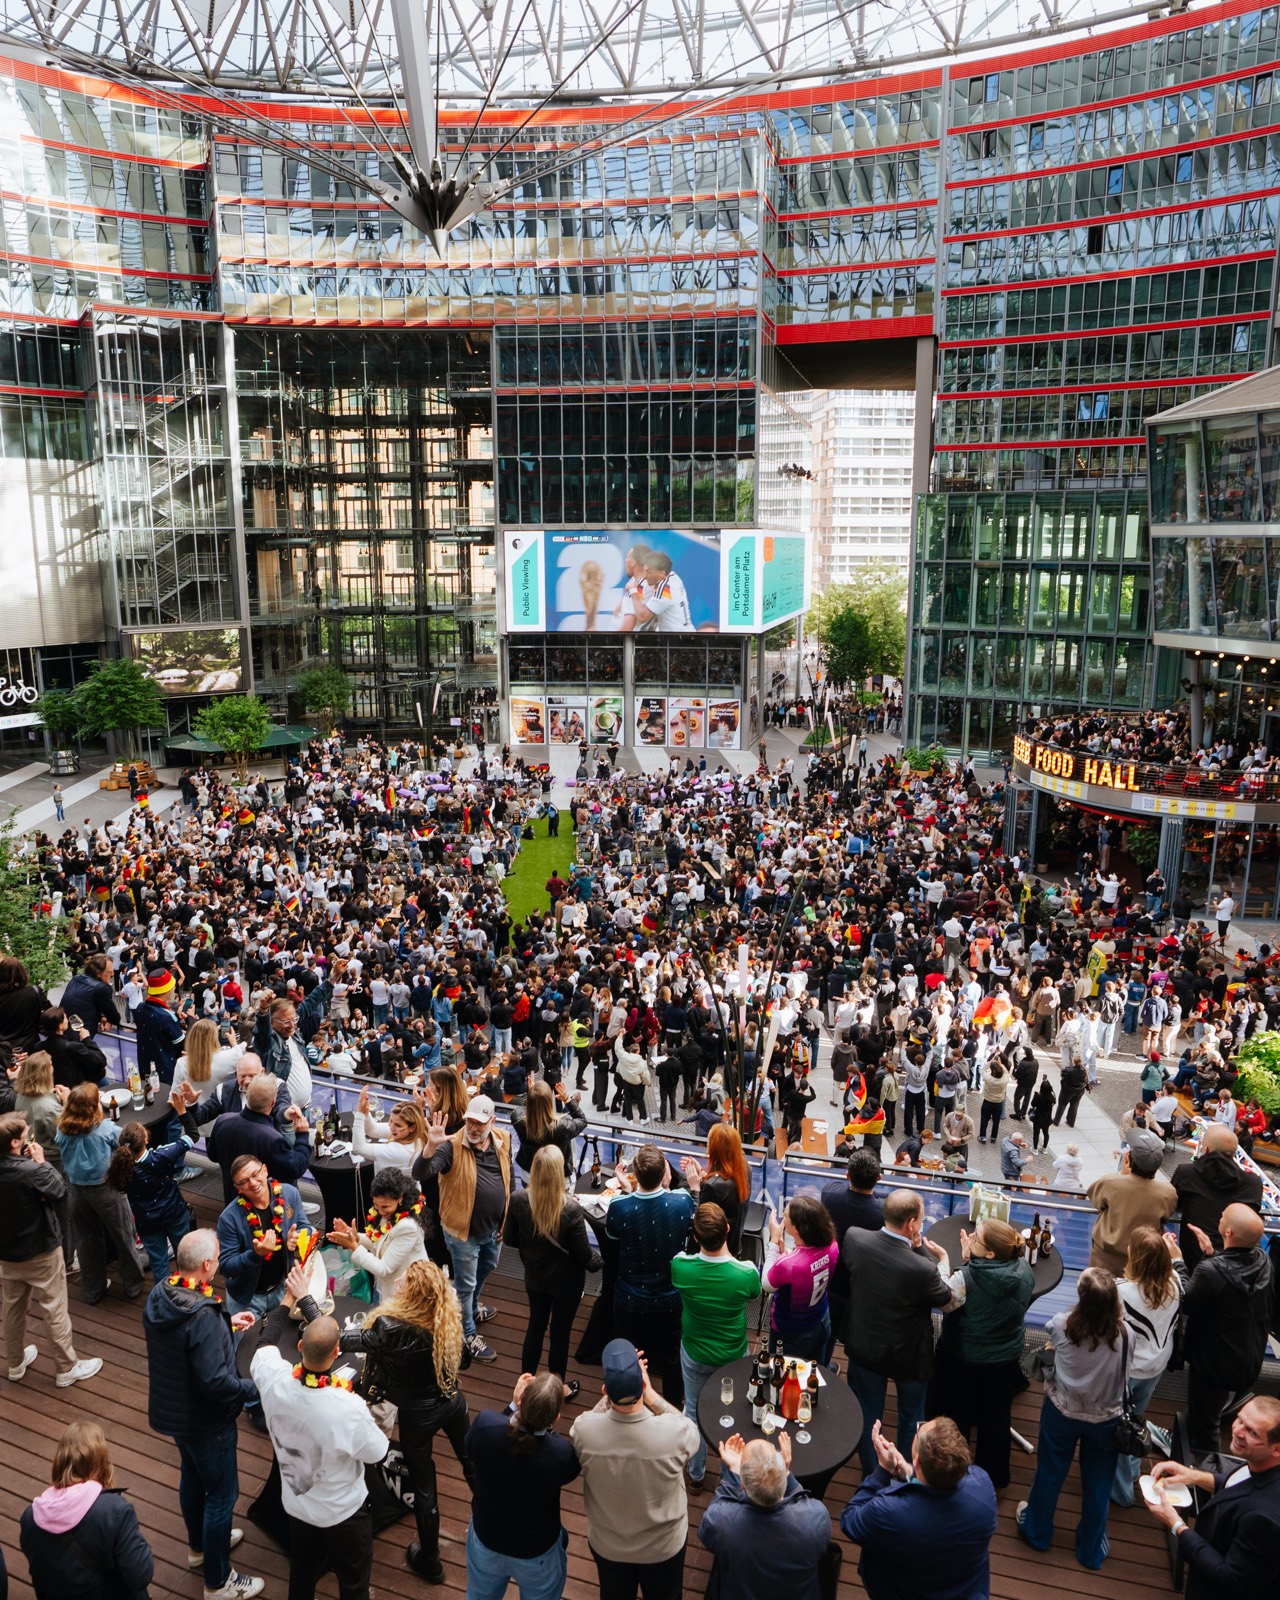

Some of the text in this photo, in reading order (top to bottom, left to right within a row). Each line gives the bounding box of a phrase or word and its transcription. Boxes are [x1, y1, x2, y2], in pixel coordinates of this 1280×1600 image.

[521, 559, 530, 616] Public Viewing
[733, 556, 741, 611] im Center am
[741, 550, 750, 617] Potsdamer Platz
[1035, 746, 1073, 777] FOOD
[1084, 758, 1139, 791] HALL
[810, 1254, 830, 1273] KROOS
